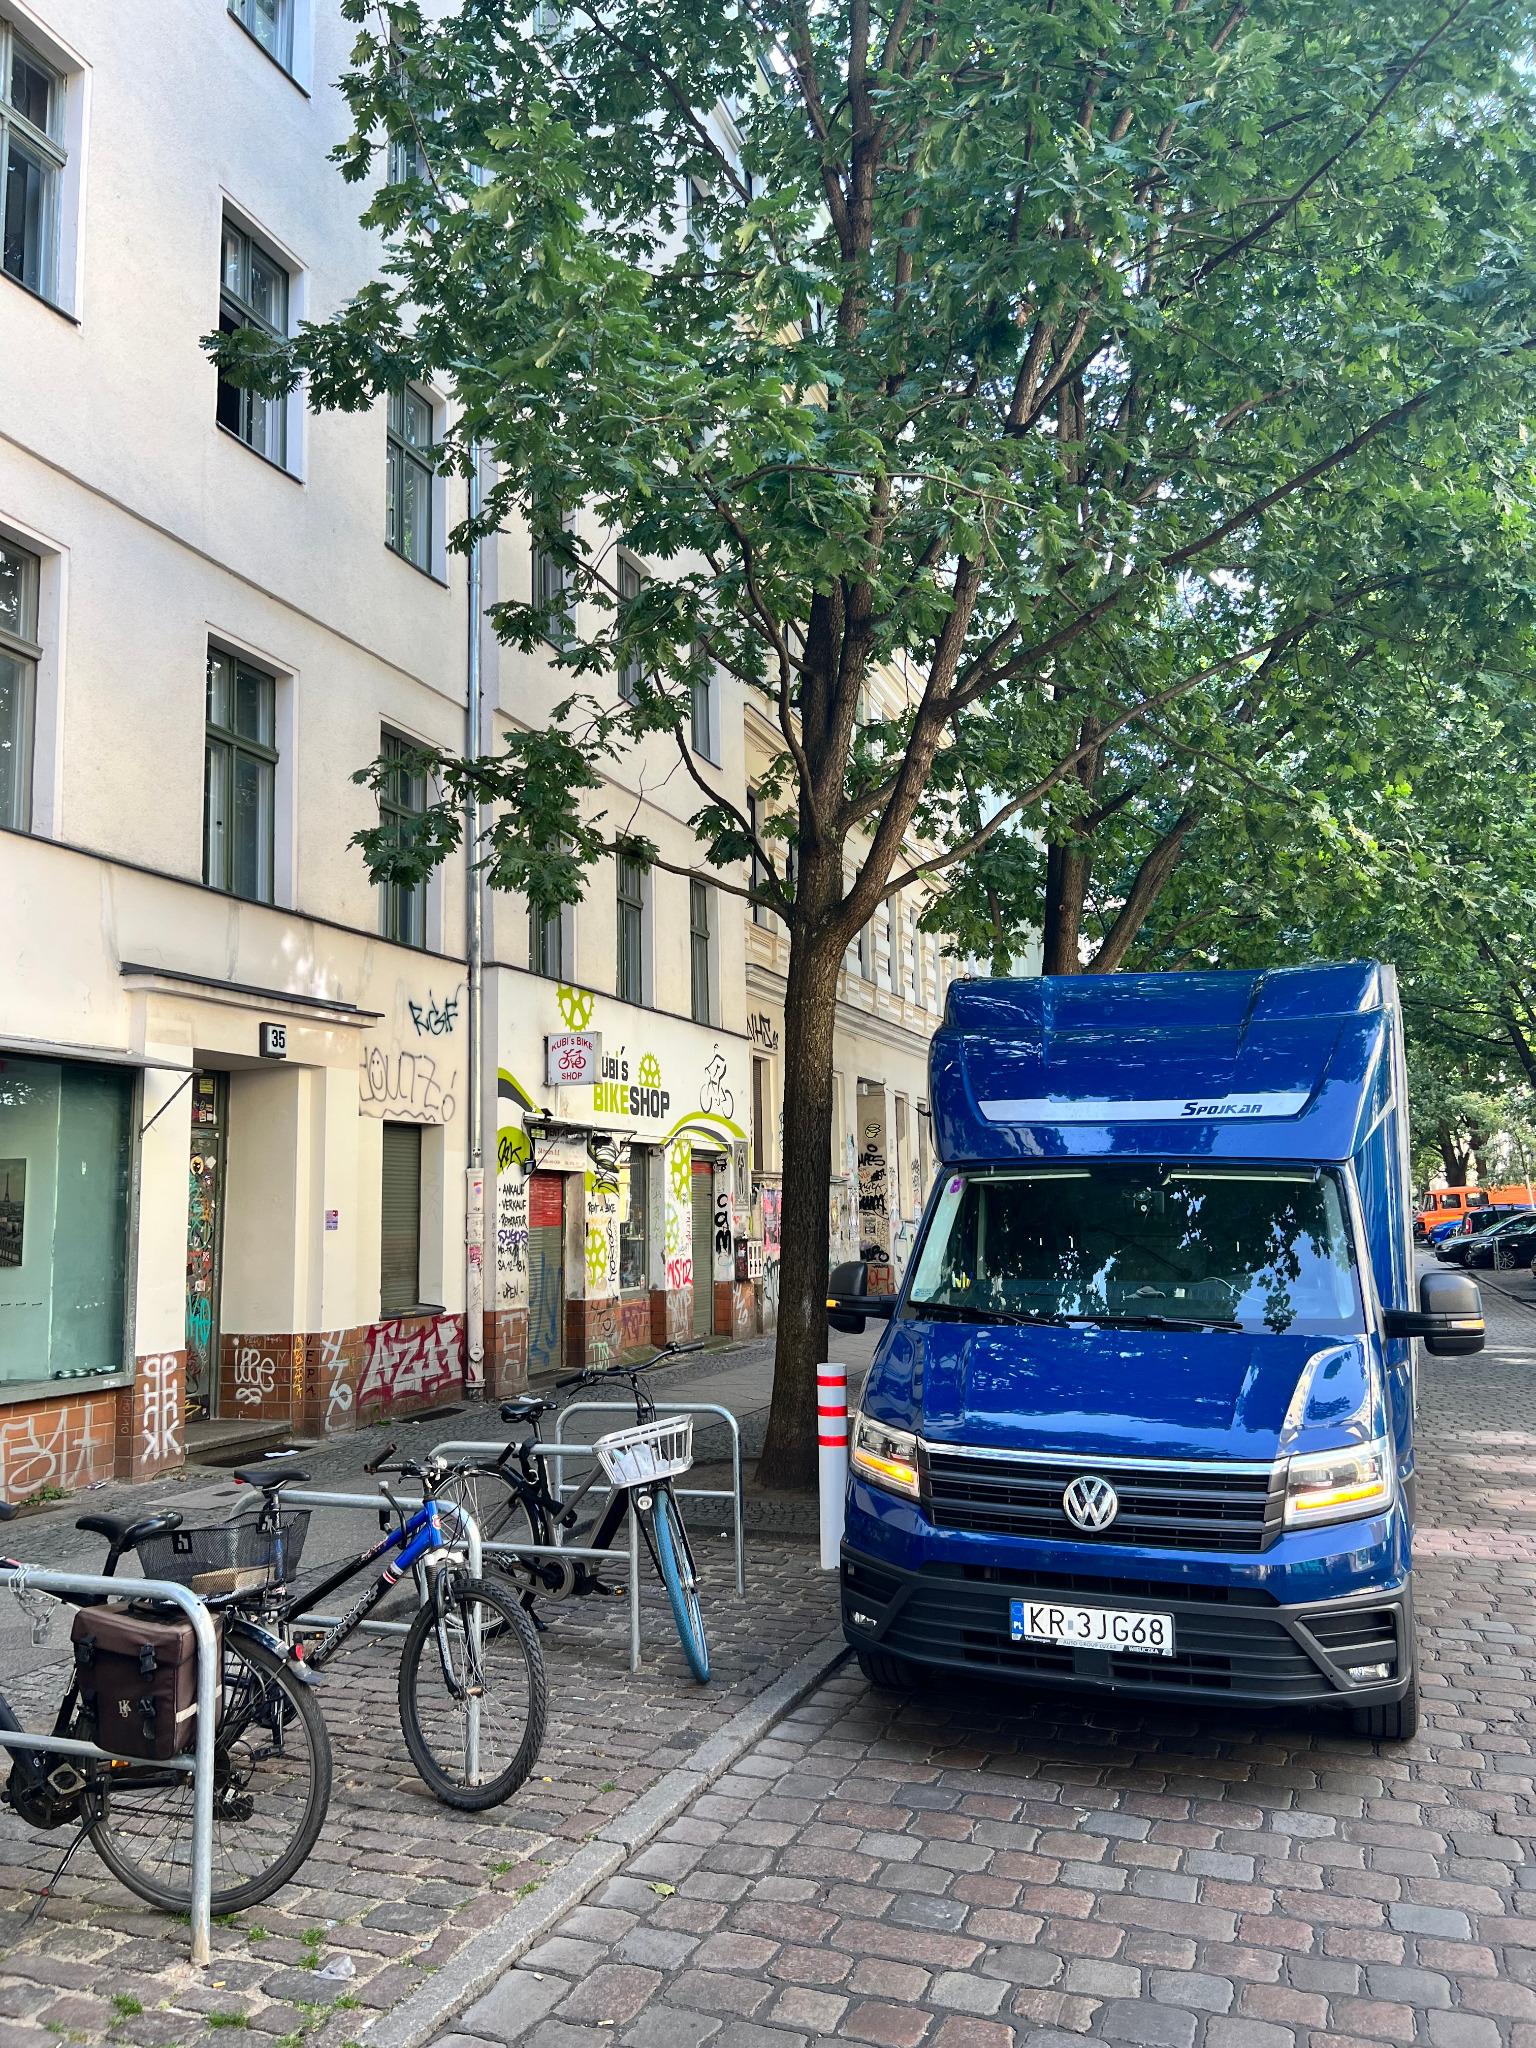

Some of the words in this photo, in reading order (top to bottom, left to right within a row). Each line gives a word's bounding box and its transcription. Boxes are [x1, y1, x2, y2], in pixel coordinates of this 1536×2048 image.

[271, 1029, 286, 1048] 35
[576, 1036, 593, 1051] BIKE
[561, 1071, 583, 1081] SHOP
[593, 1082, 670, 1118] BIKESHOP
[1063, 1476, 1118, 1532] VW
[1013, 1620, 1024, 1630] PL
[1030, 1606, 1065, 1636] KR
[1077, 1611, 1164, 1645] 3JG68
